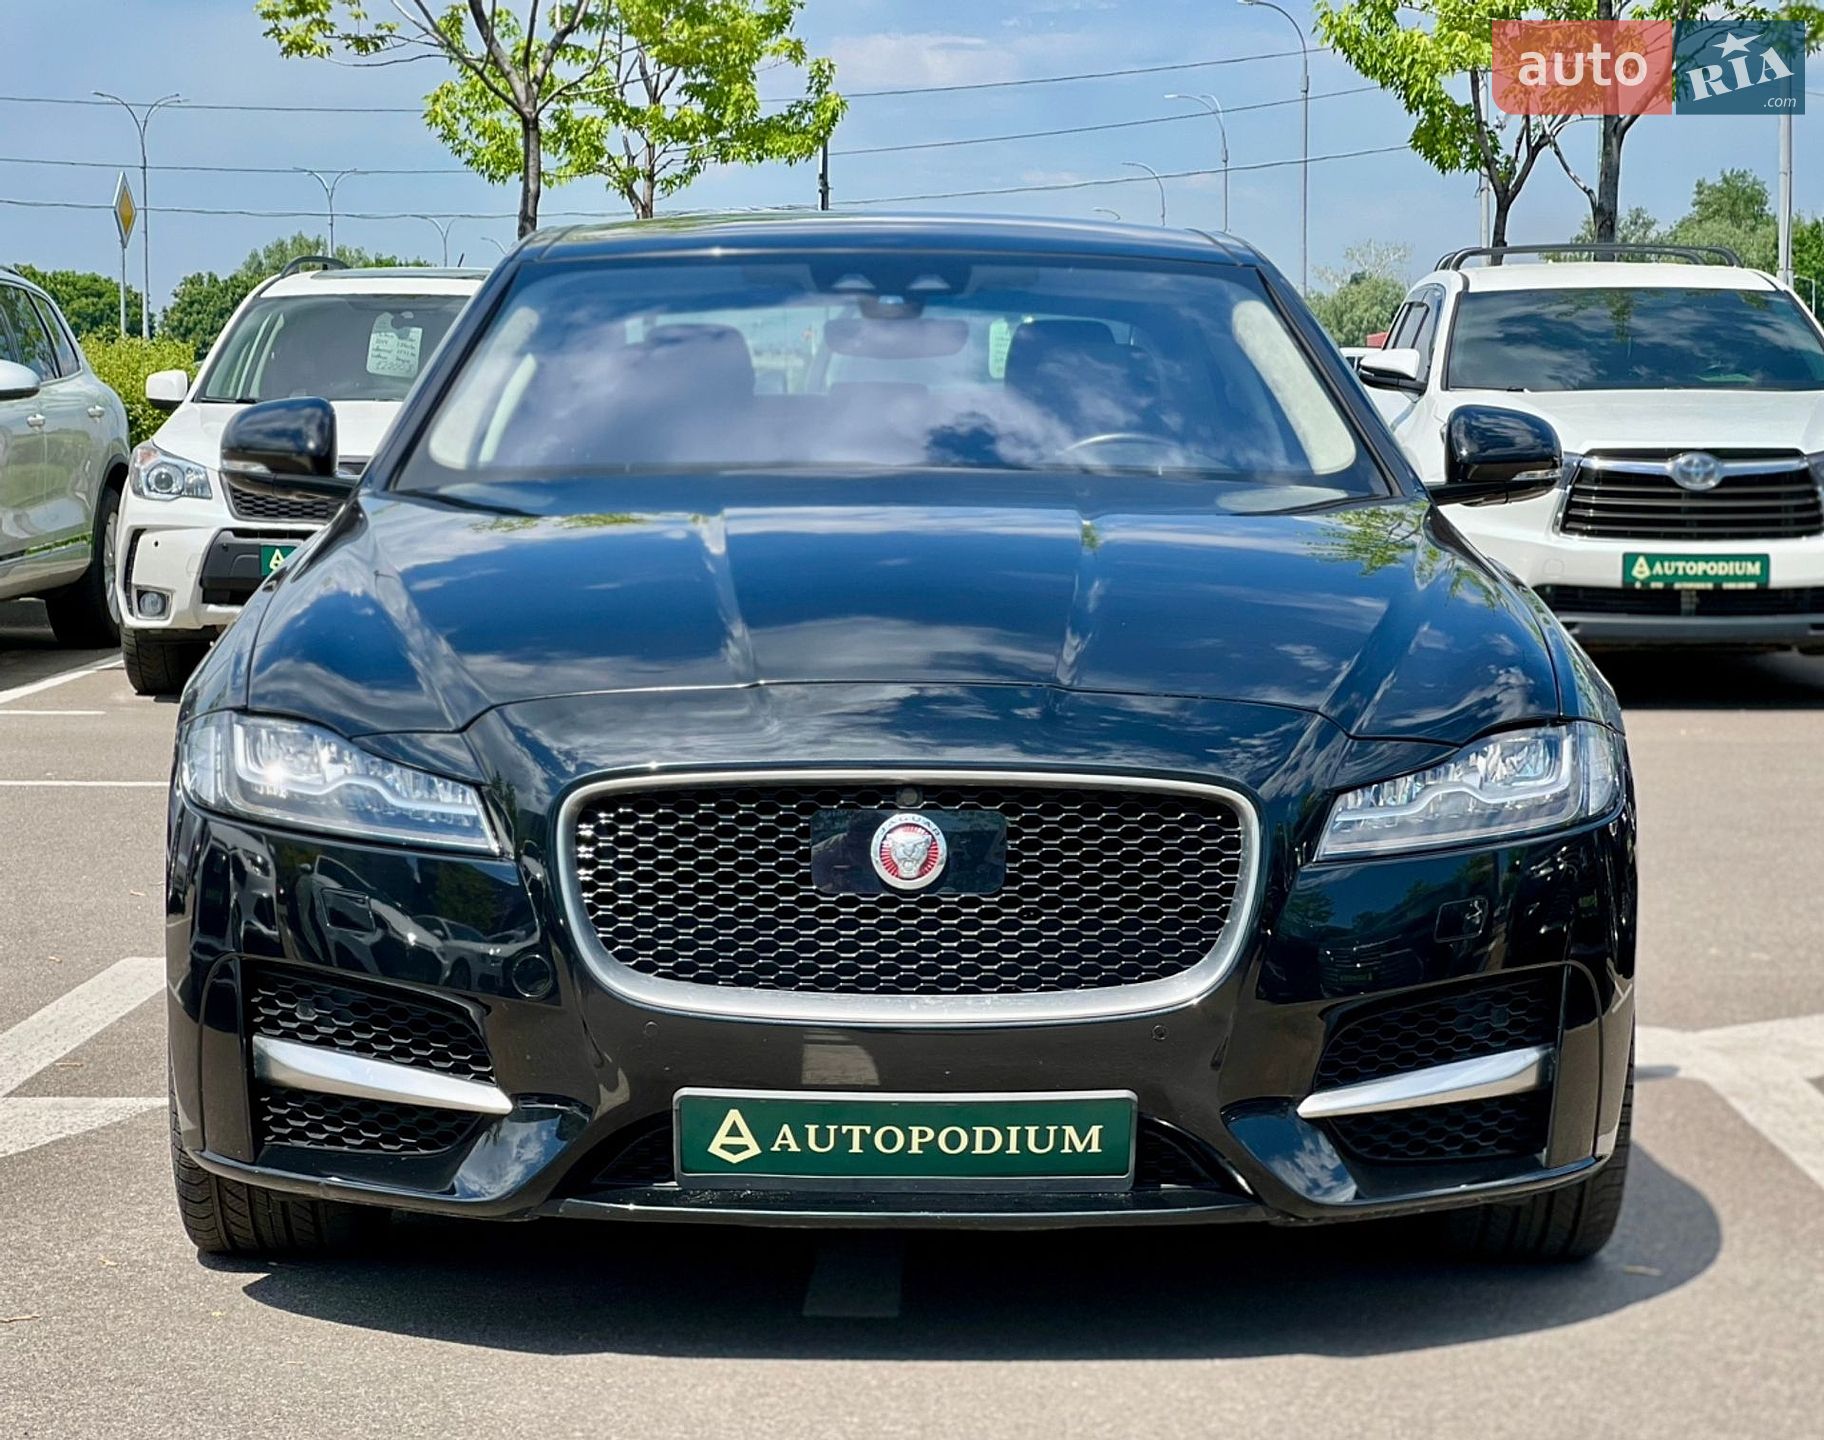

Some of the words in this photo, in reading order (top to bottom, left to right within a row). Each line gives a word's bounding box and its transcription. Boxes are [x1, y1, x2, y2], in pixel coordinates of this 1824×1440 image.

[1652, 560, 1761, 576] AUTOPODIUM
[879, 815, 941, 836] JAGUAR
[770, 1123, 1104, 1155] AUTOPODIUM
